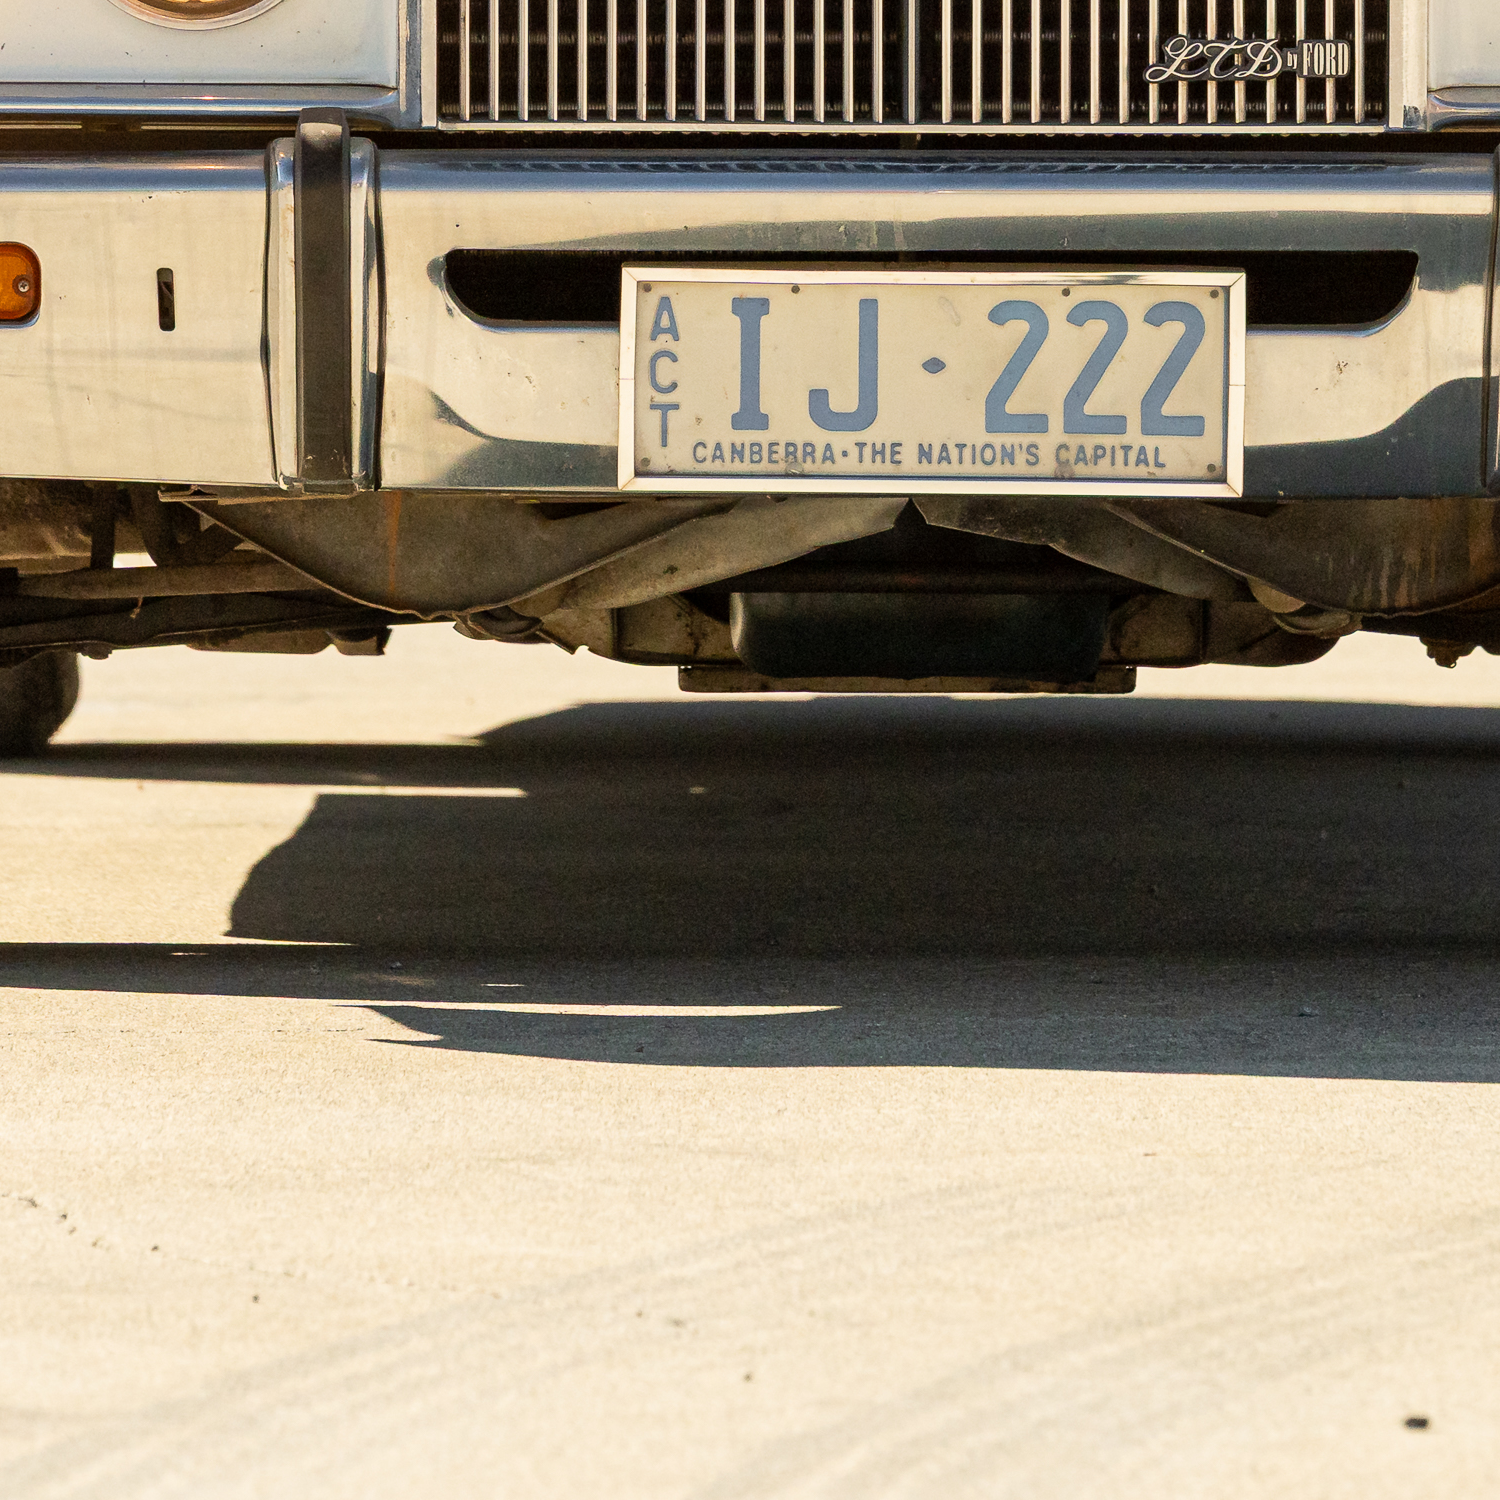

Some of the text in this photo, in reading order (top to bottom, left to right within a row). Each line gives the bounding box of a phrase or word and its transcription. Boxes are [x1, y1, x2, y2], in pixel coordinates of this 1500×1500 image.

[1145, 35, 1349, 83] LTD by FORD
[917, 442, 1040, 466] NATION'S
[1054, 443, 1167, 468] CAPITAL
